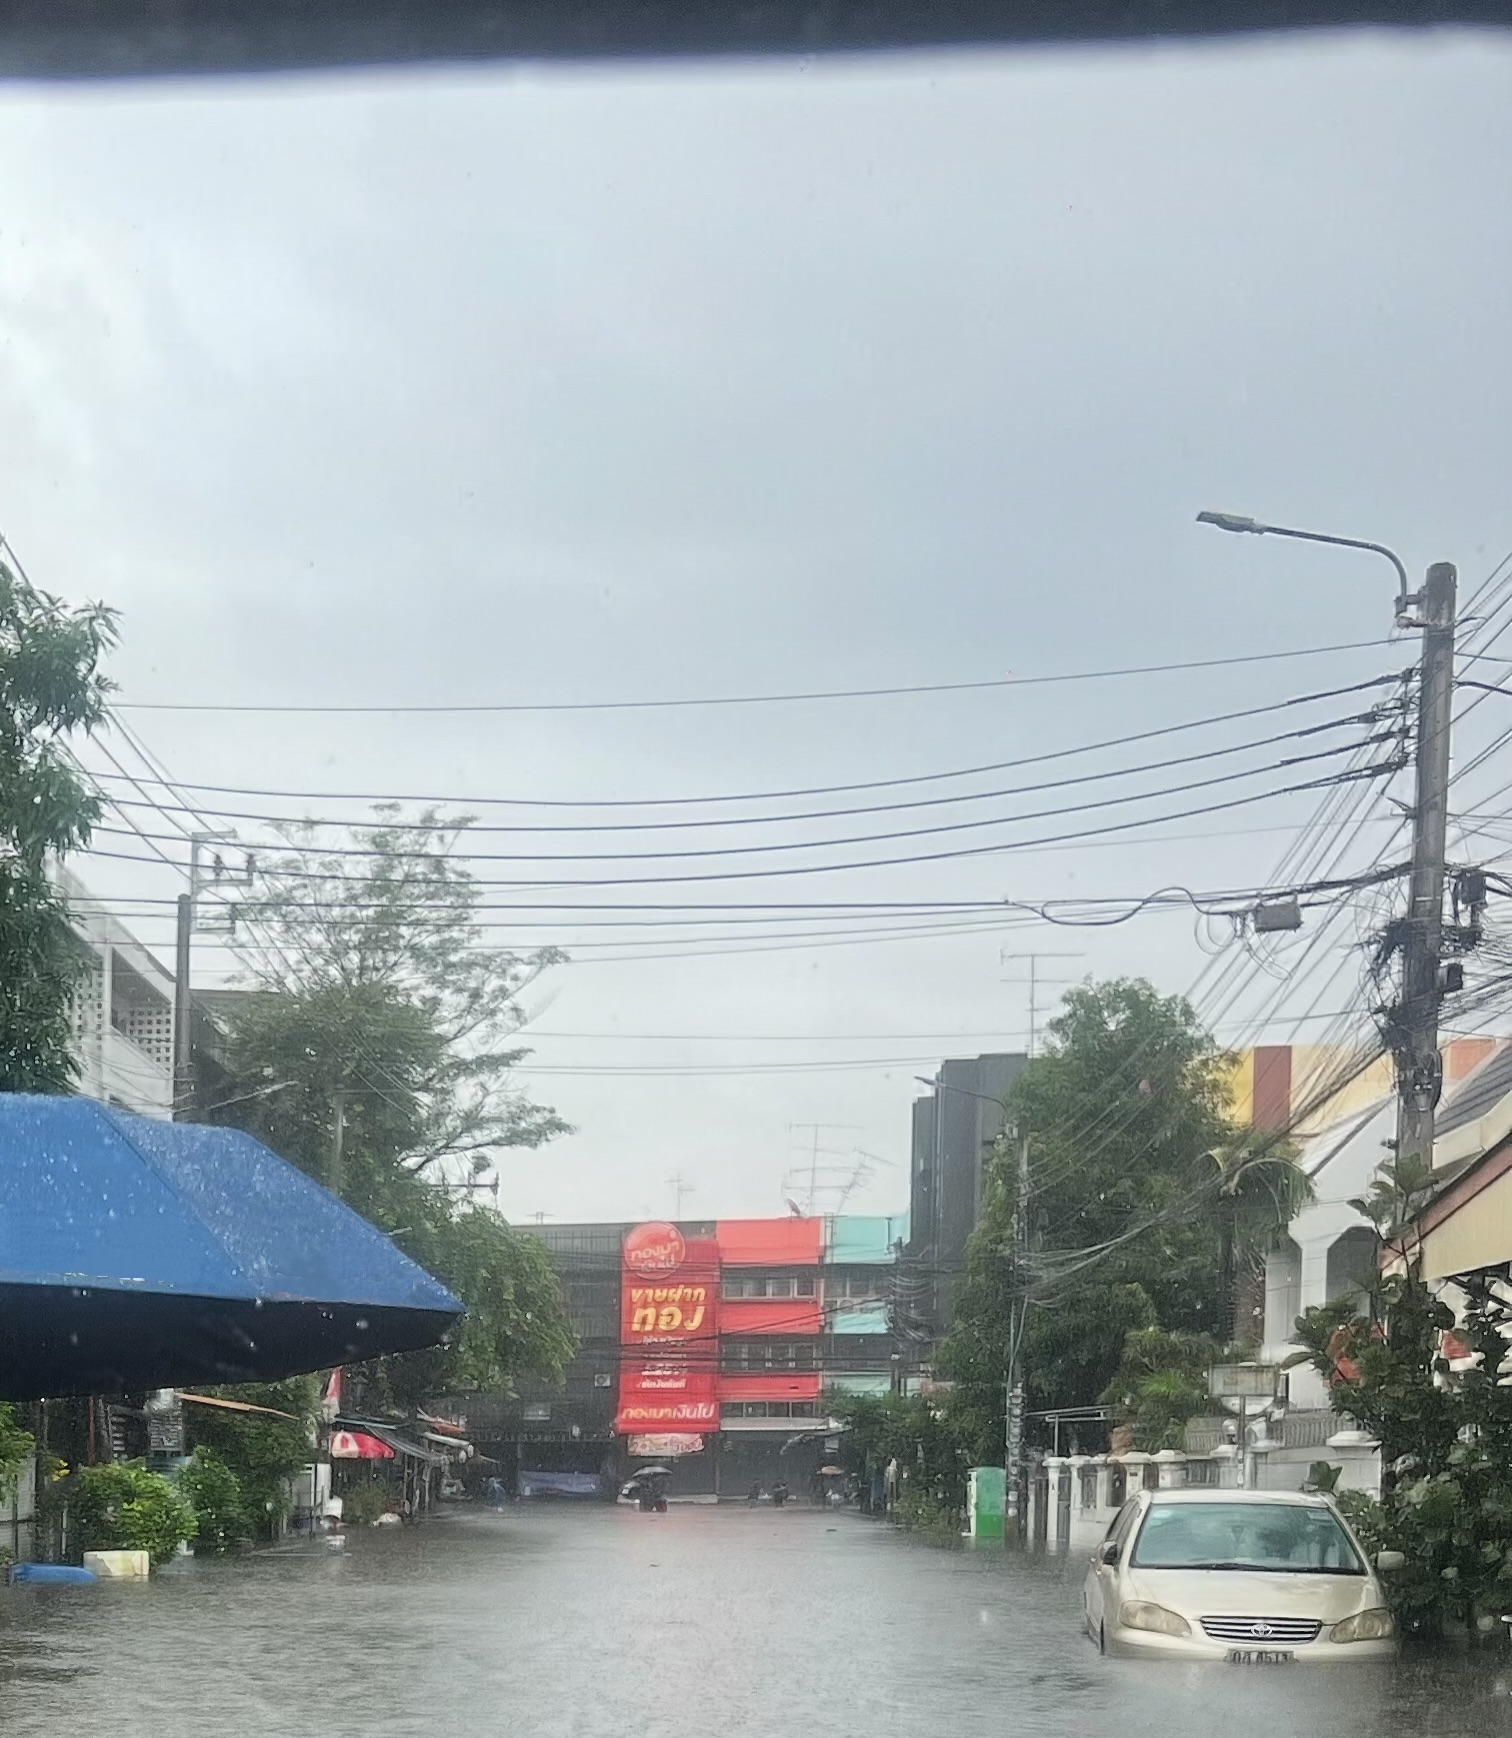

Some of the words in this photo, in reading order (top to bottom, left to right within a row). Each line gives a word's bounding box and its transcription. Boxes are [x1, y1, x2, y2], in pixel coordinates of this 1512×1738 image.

[631, 1285, 706, 1303] ขายฝาก
[631, 1306, 705, 1331] ทอง
